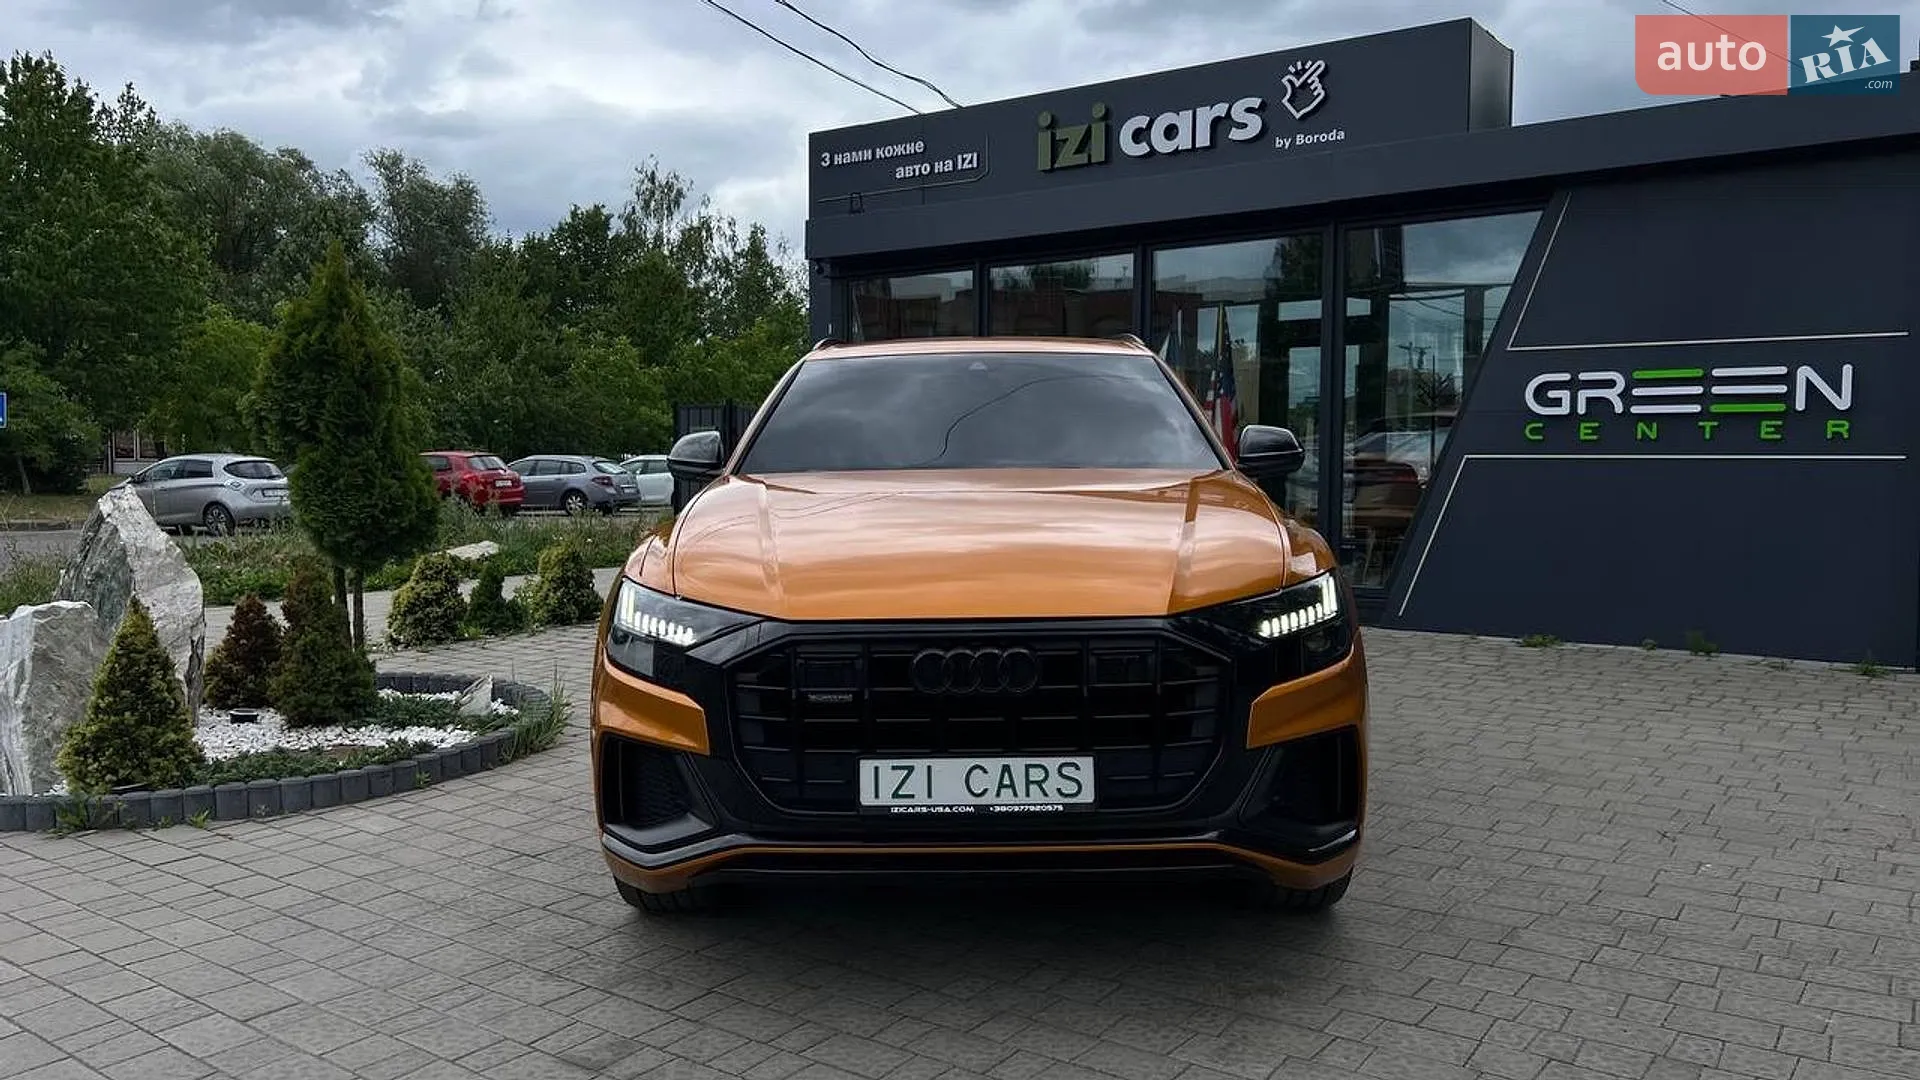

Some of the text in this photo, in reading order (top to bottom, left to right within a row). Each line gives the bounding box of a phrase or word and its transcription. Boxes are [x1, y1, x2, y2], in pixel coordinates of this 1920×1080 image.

[1037, 97, 1263, 171] izi cars
[1275, 129, 1345, 150] by Boroda
[833, 149, 873, 165] нами
[875, 140, 925, 160] кожне
[895, 152, 978, 179] авто на IZI
[1524, 363, 1854, 416] GREEN
[1524, 419, 1850, 440] CENTER
[873, 761, 1084, 800] IZI CARS
